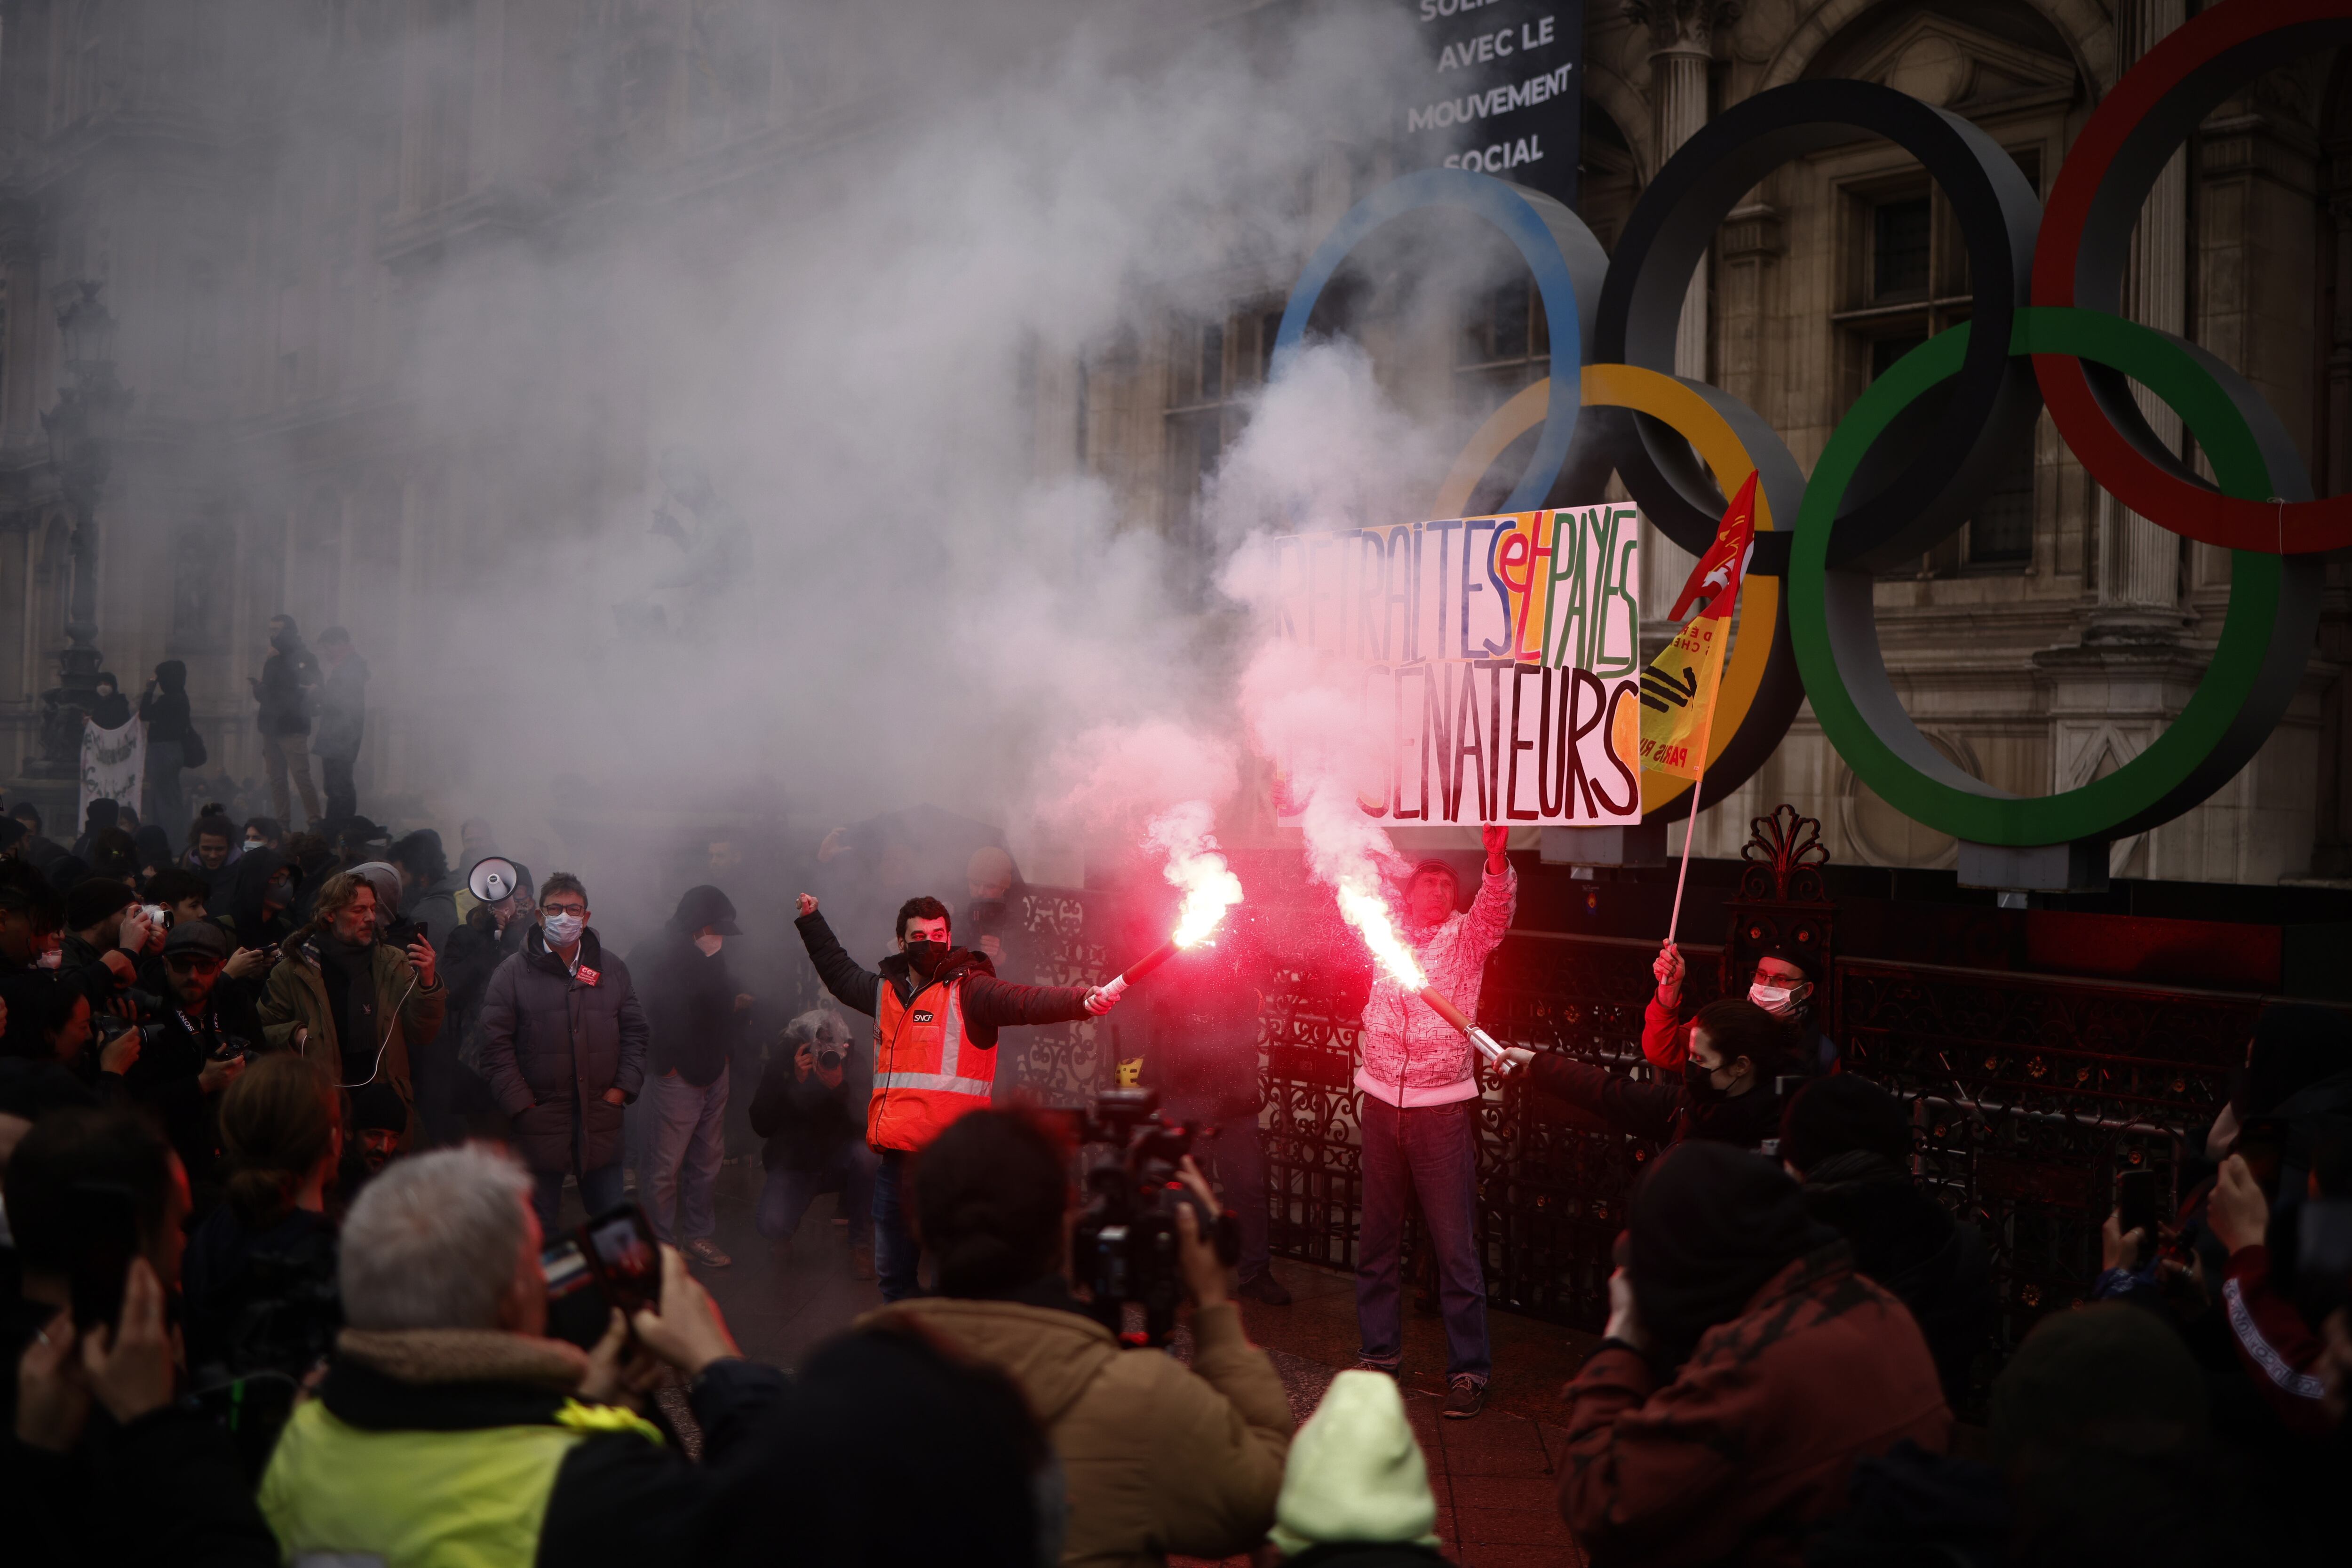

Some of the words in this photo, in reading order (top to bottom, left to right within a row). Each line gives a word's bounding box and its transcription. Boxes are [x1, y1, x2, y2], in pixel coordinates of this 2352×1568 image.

[1437, 28, 1514, 73] AVEC
[1522, 16, 1555, 50] LE
[1408, 63, 1572, 133] MOUVEMENT
[1499, 511, 1551, 661] et
[581, 967, 597, 977] CGT
[176, 1010, 195, 1032] SONY
